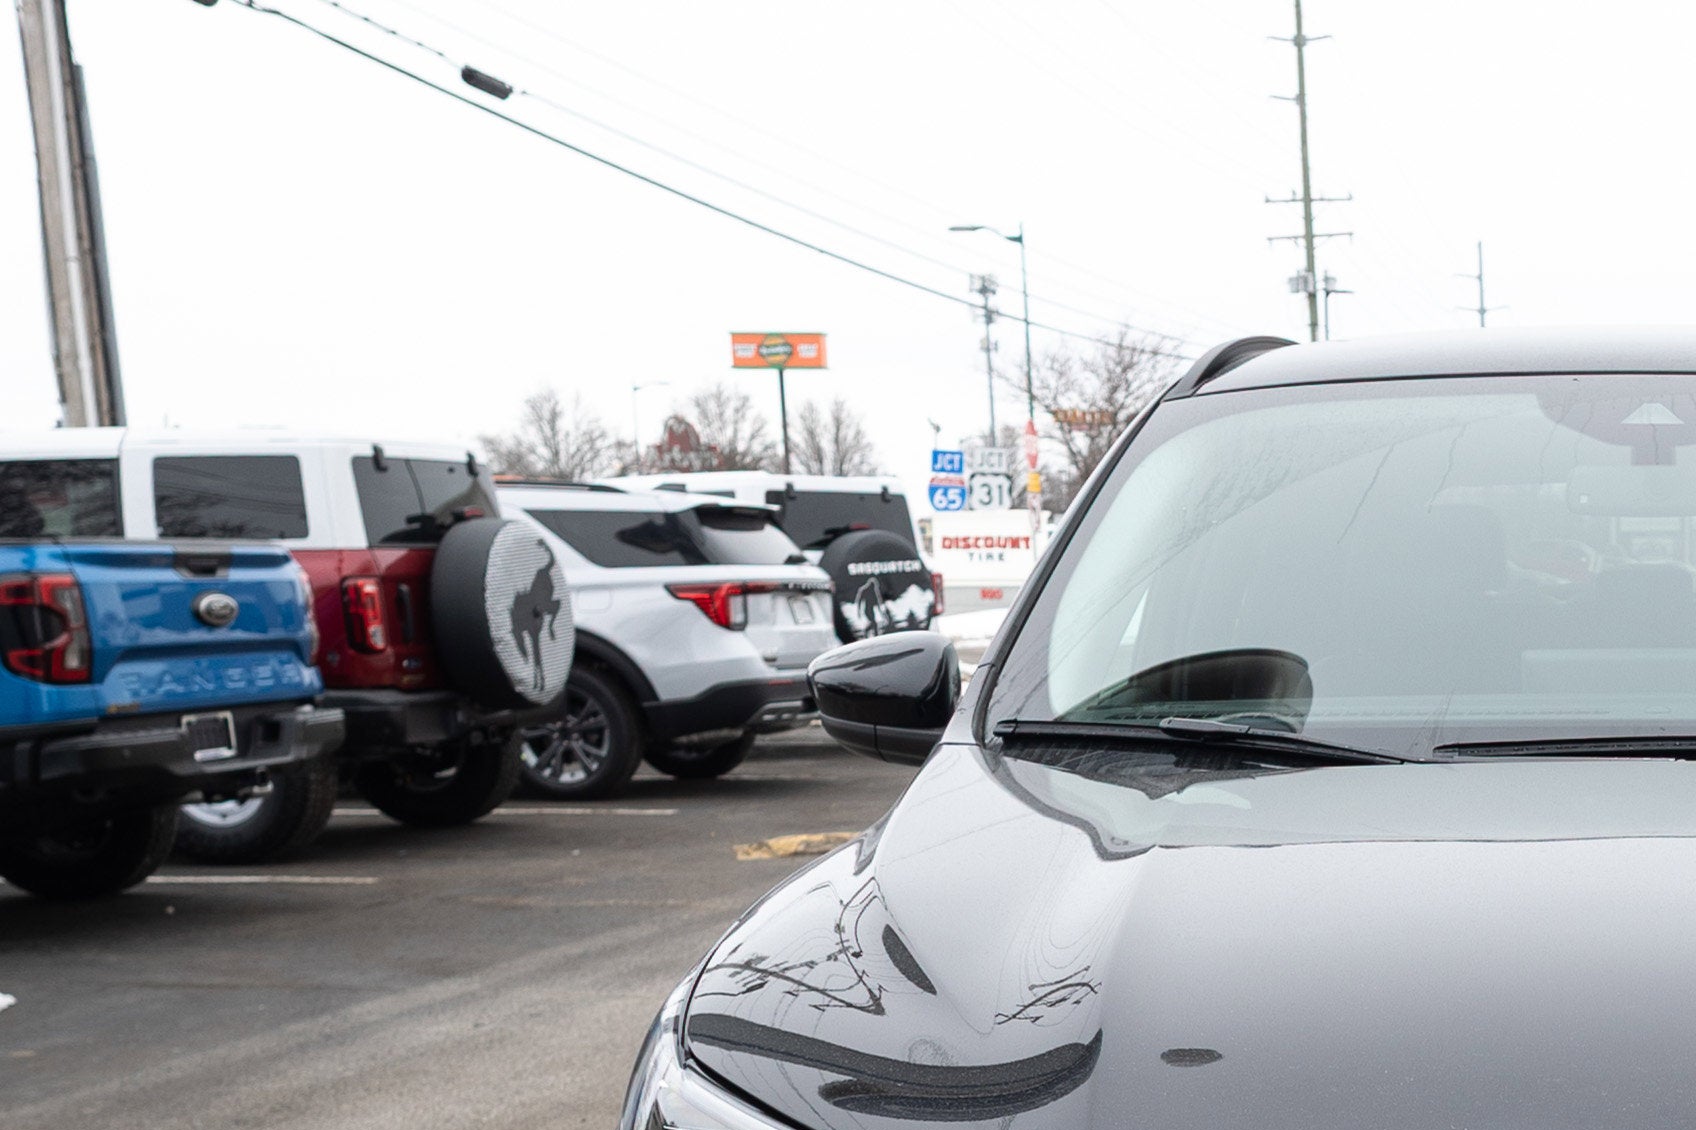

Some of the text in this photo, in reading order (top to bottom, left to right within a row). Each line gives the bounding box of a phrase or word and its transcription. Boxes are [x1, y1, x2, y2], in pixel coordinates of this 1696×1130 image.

[934, 453, 961, 471] JCT
[979, 452, 1003, 468] JCT
[933, 488, 963, 510] 65
[980, 483, 1003, 506] 31
[942, 536, 1030, 549] DISCOUNT
[969, 552, 1005, 561] TIRE
[847, 559, 922, 576] SASQUATCH
